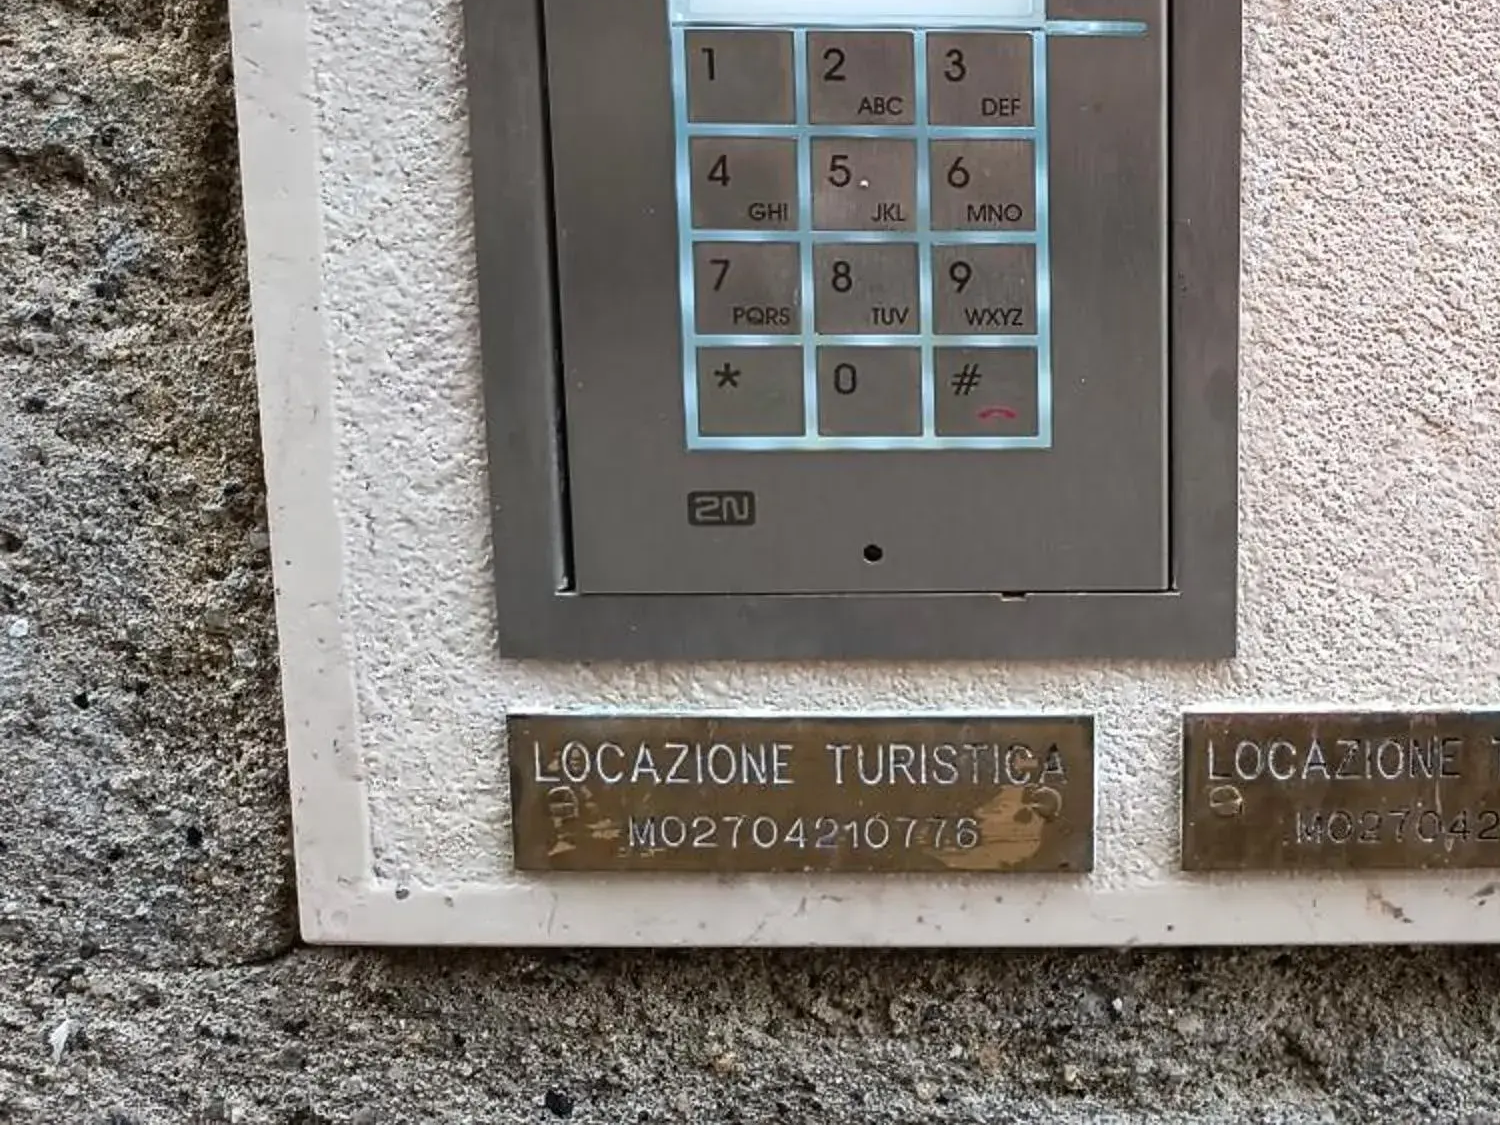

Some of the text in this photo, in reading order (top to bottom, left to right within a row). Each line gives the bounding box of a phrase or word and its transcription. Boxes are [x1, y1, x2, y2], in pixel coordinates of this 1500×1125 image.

[702, 48, 967, 82] 1 2 3
[857, 96, 1022, 117] ABC DEF
[707, 155, 970, 188] 4 5 6
[748, 203, 1023, 223] GHI JKL MNO
[710, 259, 973, 293] 7 8 9
[733, 307, 1024, 327] PQRS TUV WXYZ
[833, 363, 857, 395] 0
[952, 363, 982, 396] #
[533, 741, 1068, 786] LOCAZIONE TURISTICA
[1207, 736, 1463, 781] LOCAZIONE
